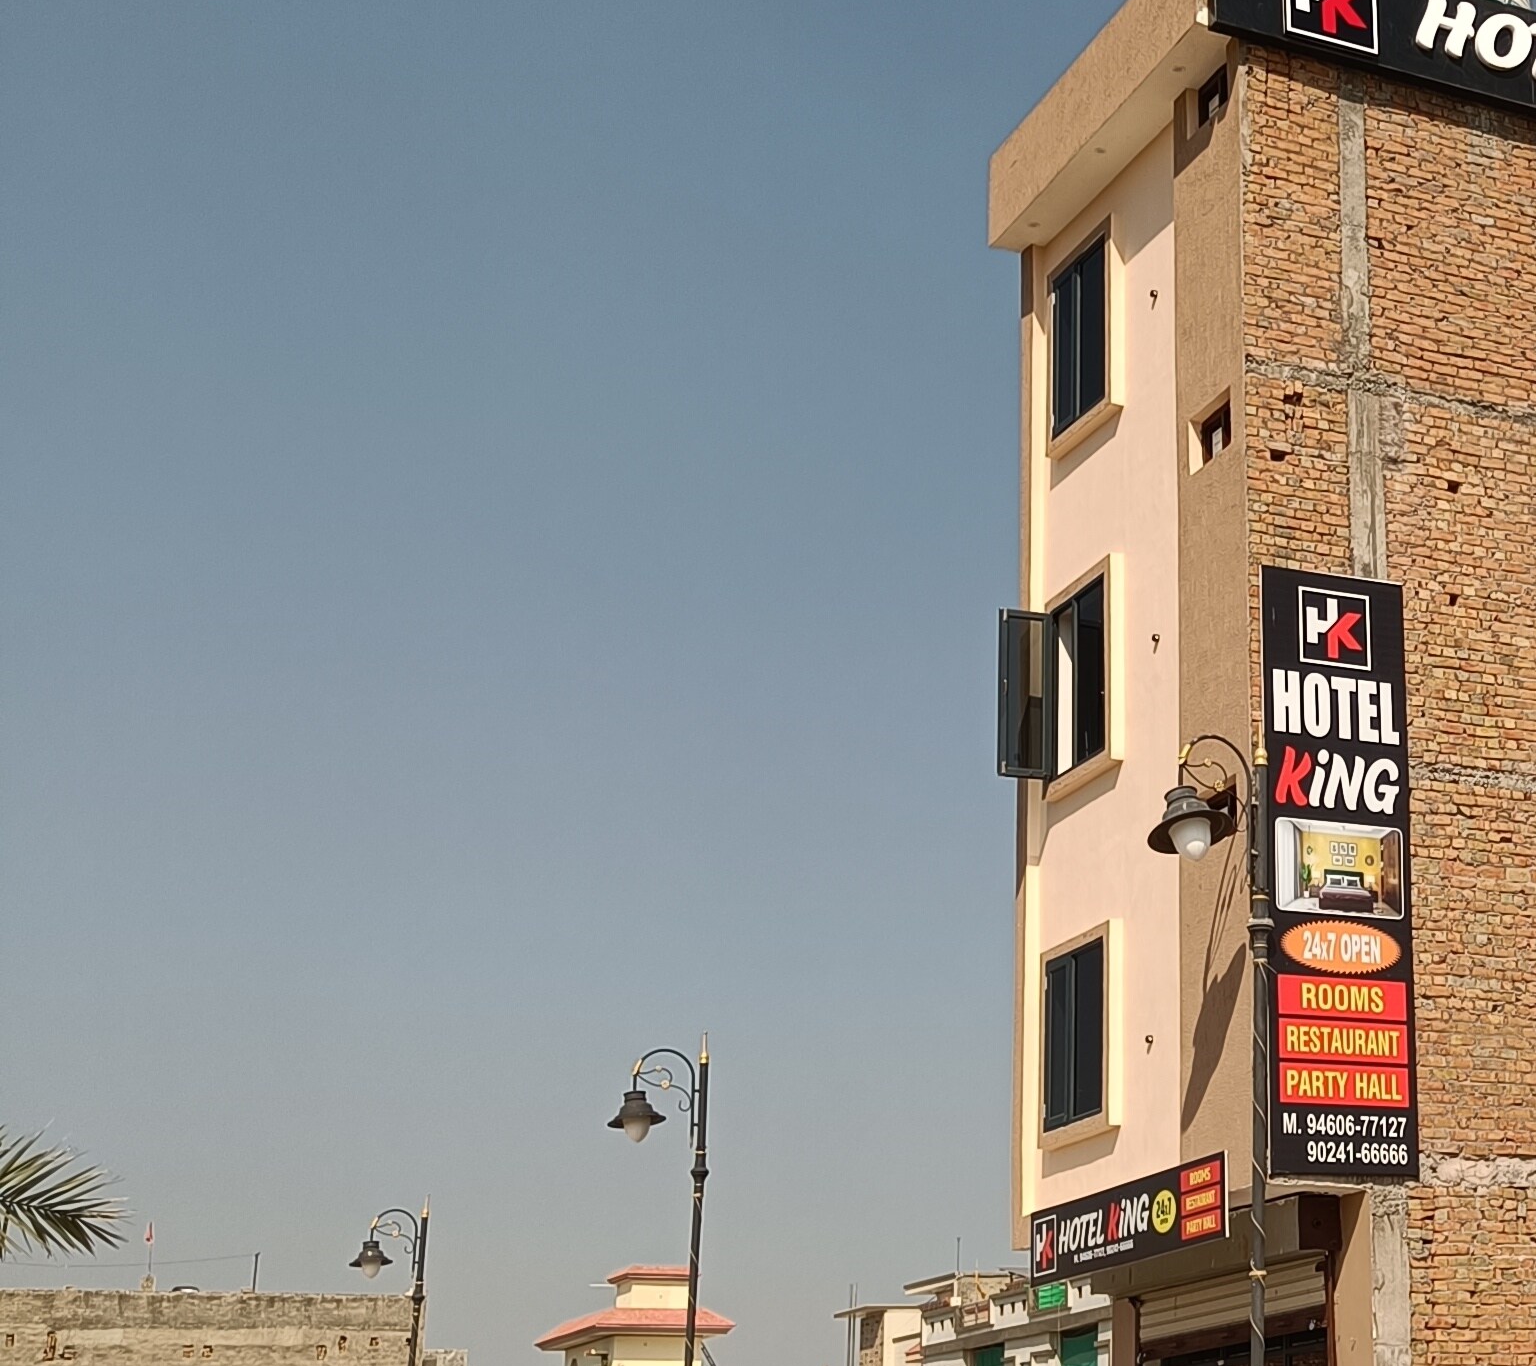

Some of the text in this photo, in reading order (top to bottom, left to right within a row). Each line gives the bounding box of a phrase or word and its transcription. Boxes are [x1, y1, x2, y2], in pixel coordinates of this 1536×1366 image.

[1273, 669, 1400, 745] HOTEL
[1303, 930, 1382, 964] 24x7 OPEN
[1301, 982, 1385, 1014] ROOMS
[1287, 1025, 1400, 1057] RESTAURANT
[1286, 1069, 1403, 1101] PARTY HALL
[1283, 1113, 1407, 1138] M. 94606-77127
[1307, 1141, 1408, 1166] 90241-66666
[1058, 1209, 1105, 1255] HOTEL
